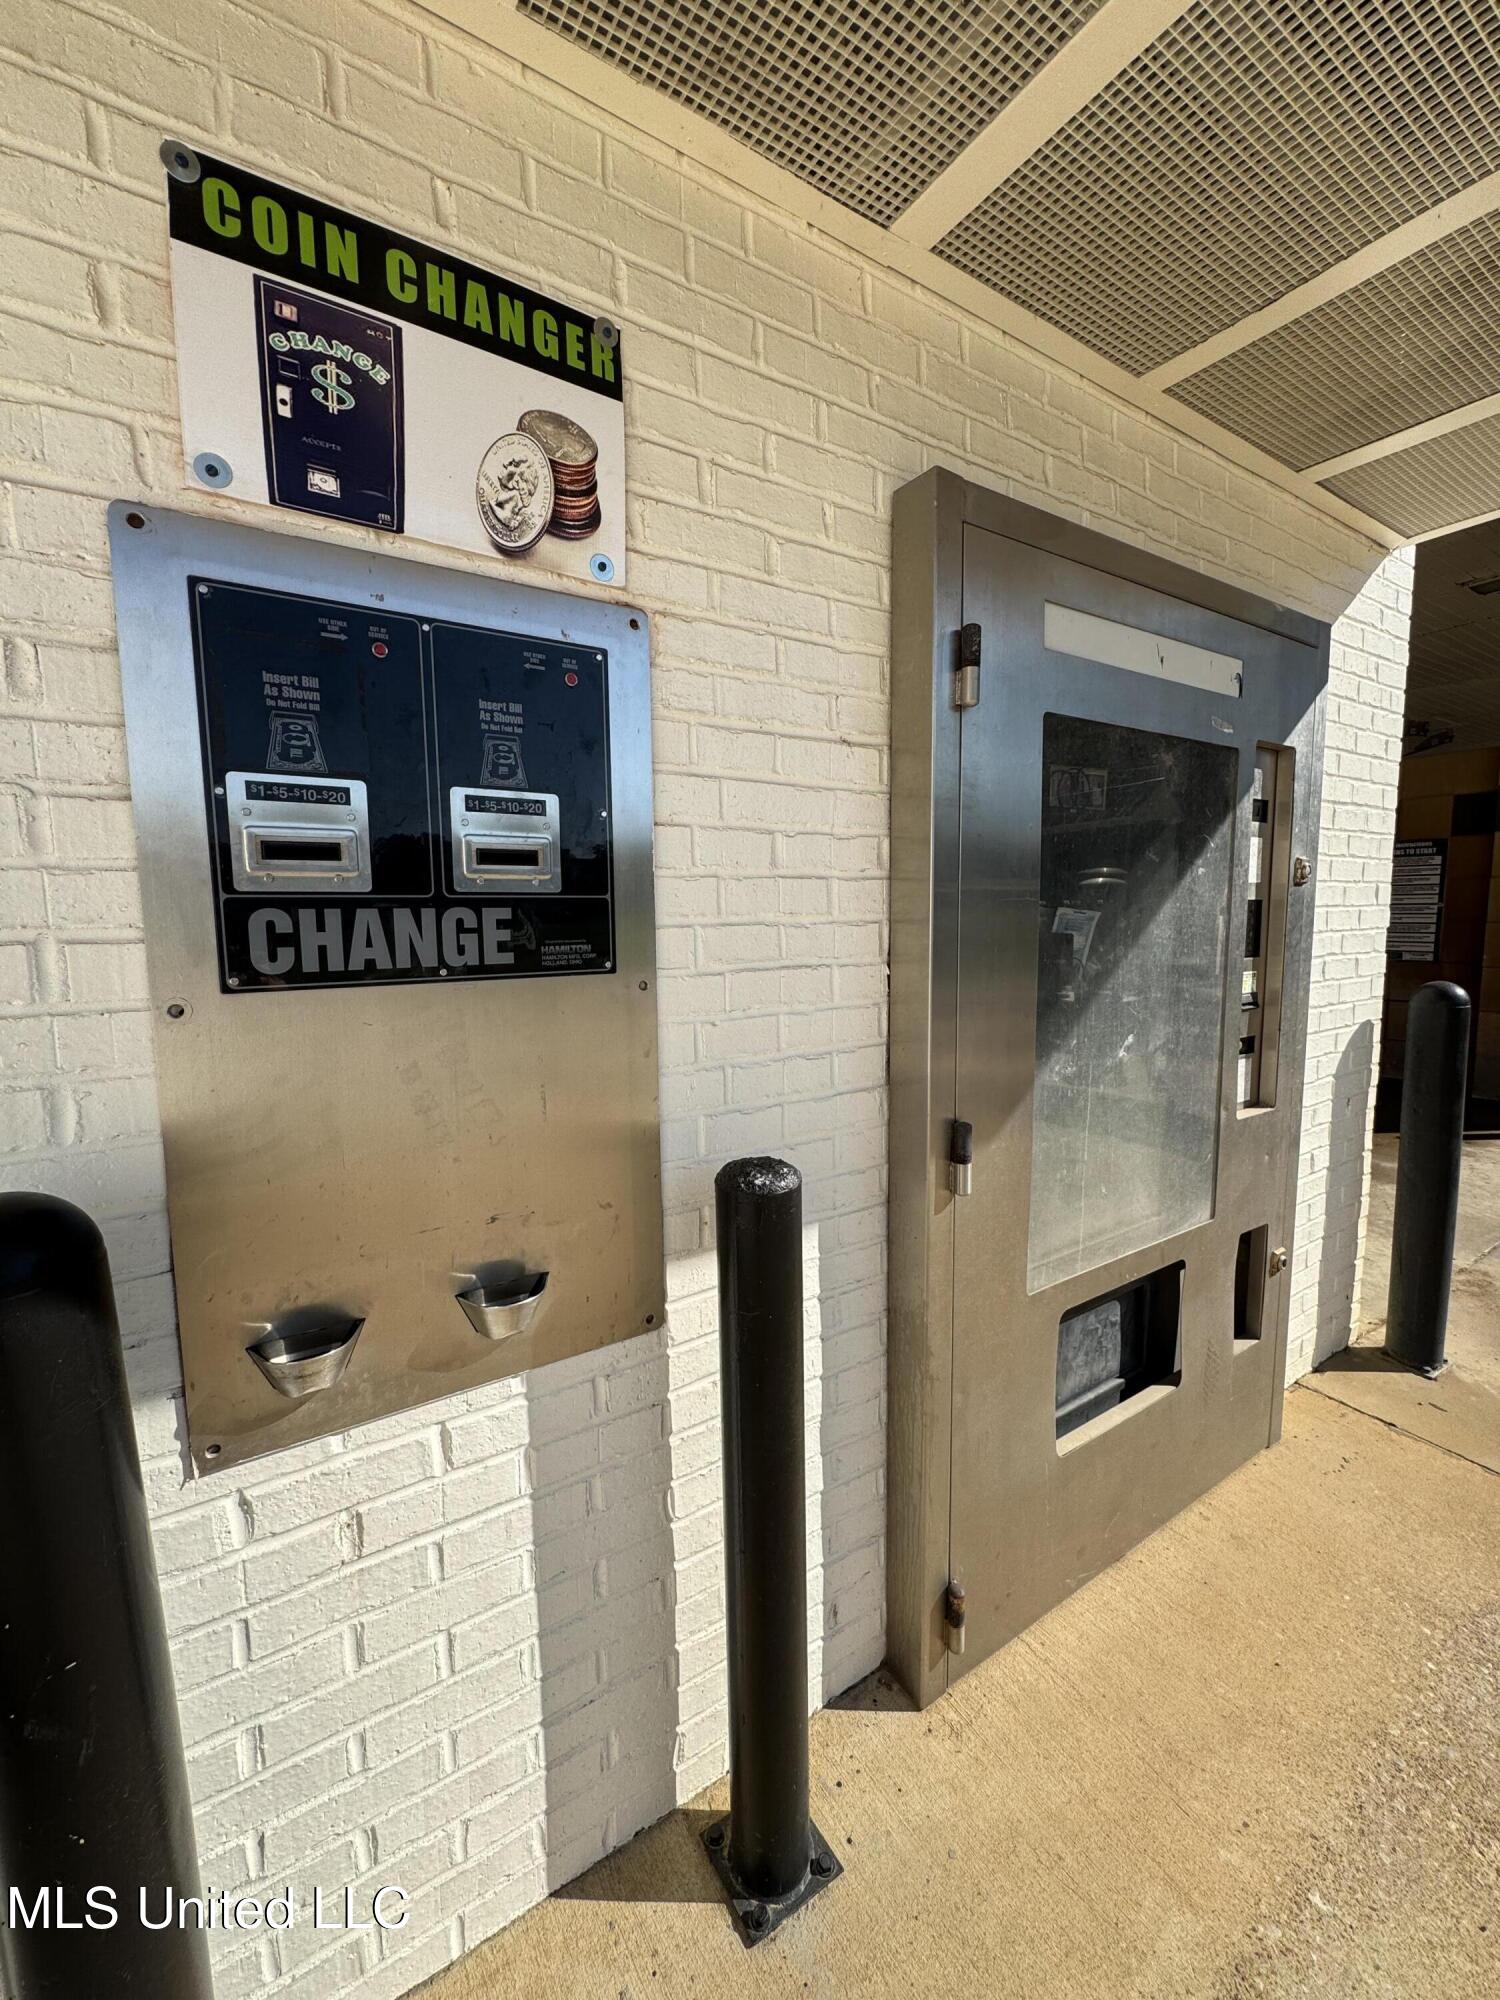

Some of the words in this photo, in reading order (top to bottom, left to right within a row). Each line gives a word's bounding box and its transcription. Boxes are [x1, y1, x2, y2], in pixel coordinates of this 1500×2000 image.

[202, 177, 360, 284] COIN
[386, 248, 616, 384] CHANGER
[268, 330, 391, 386] CHANGE
[301, 435, 342, 451] ACCEPTS
[262, 670, 299, 686] Insert
[301, 675, 320, 688] Bill
[263, 683, 279, 696] As
[281, 686, 321, 701] Shown
[266, 698, 276, 706] Do
[277, 699, 291, 708] Not
[292, 701, 307, 710] Fold
[309, 703, 320, 711] Bill
[478, 698, 507, 712] Insert
[508, 702, 523, 714] Bill
[479, 710, 491, 721] As
[493, 711, 524, 725] Shown
[481, 722, 489, 730] Do
[490, 723, 500, 731] Not
[501, 725, 513, 733] Fold
[249, 784, 347, 804] $1-$5-$10-$20
[468, 799, 543, 814] $1-$5-$10-$20
[247, 907, 515, 975] CHANGE
[541, 944, 591, 954] HAMILTON
[541, 953, 569, 961] HAMILTON
